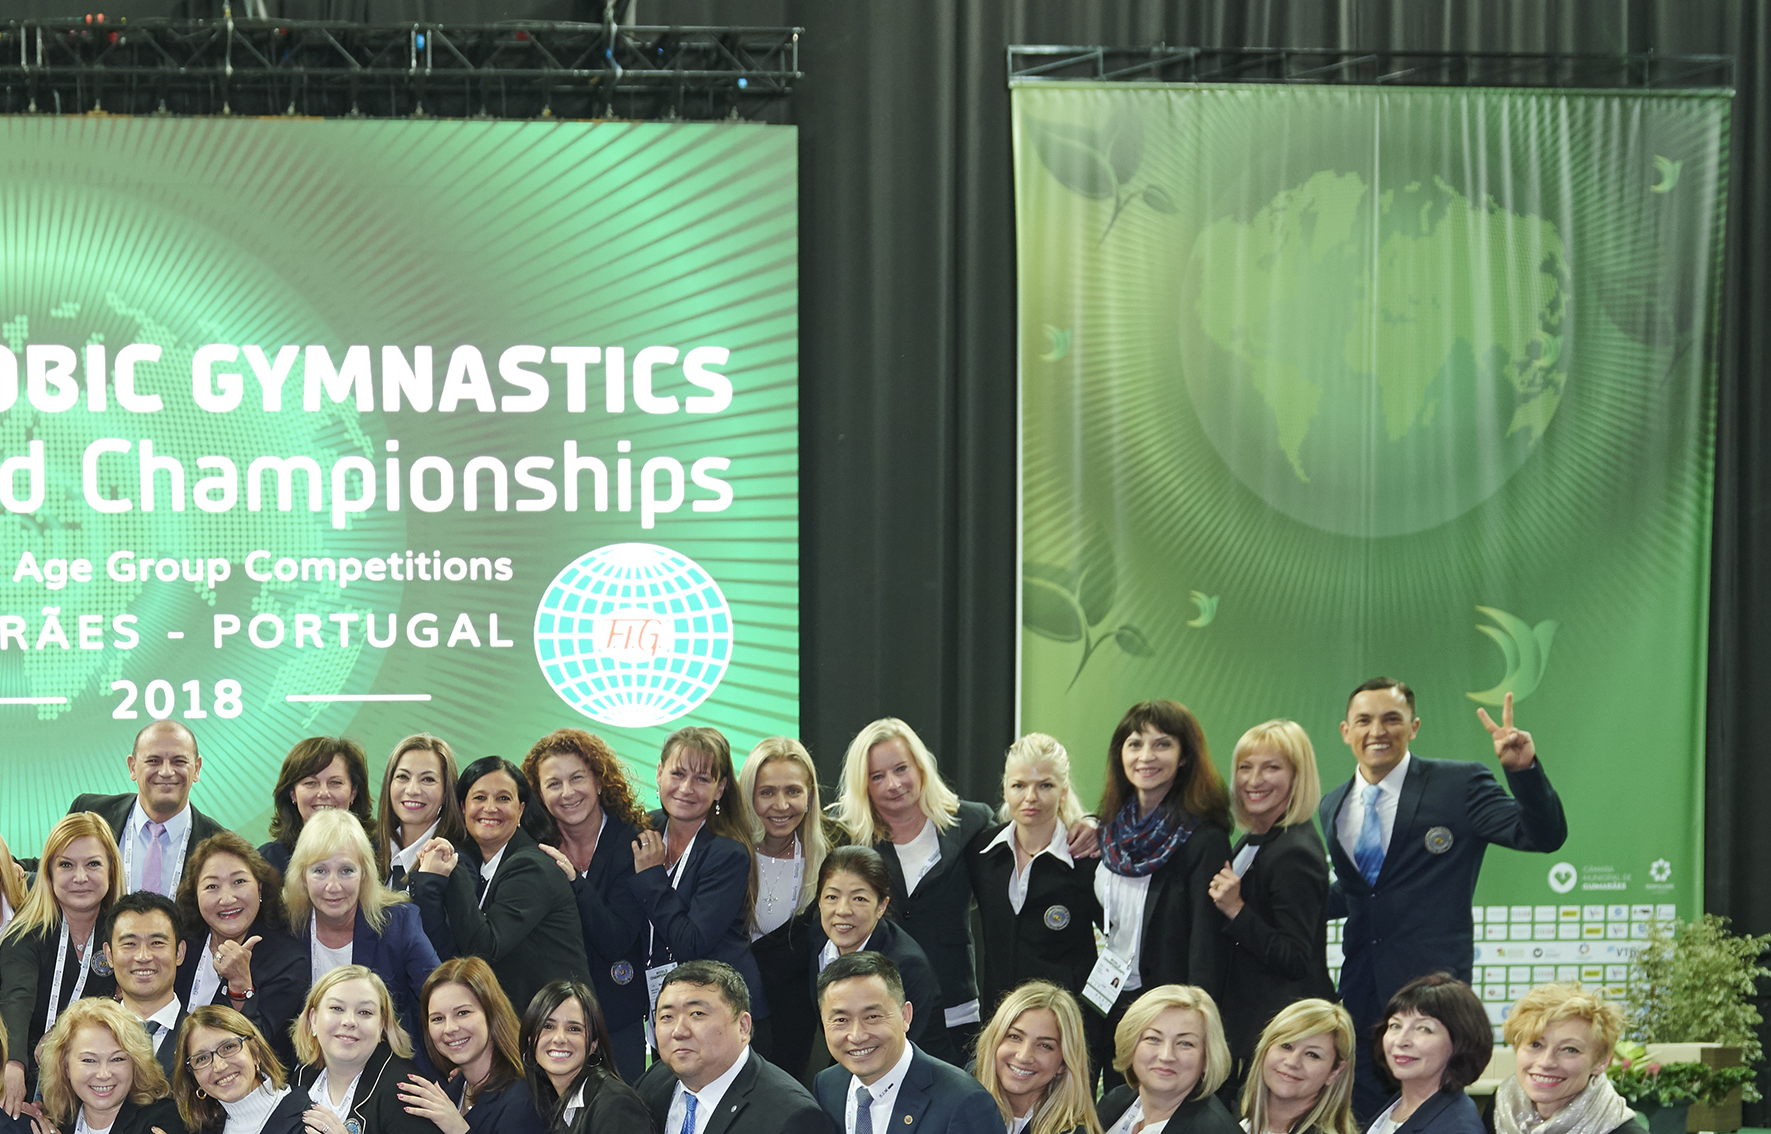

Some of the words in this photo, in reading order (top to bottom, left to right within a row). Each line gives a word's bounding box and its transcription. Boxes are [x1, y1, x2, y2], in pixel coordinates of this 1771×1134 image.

[192, 343, 734, 415] GYMNASTICS
[82, 437, 735, 530] Championships
[12, 550, 93, 591] Age
[106, 549, 231, 589] Group
[244, 549, 514, 589] Competitions
[212, 611, 514, 650] PORTUGAL
[109, 677, 245, 722] 2018
